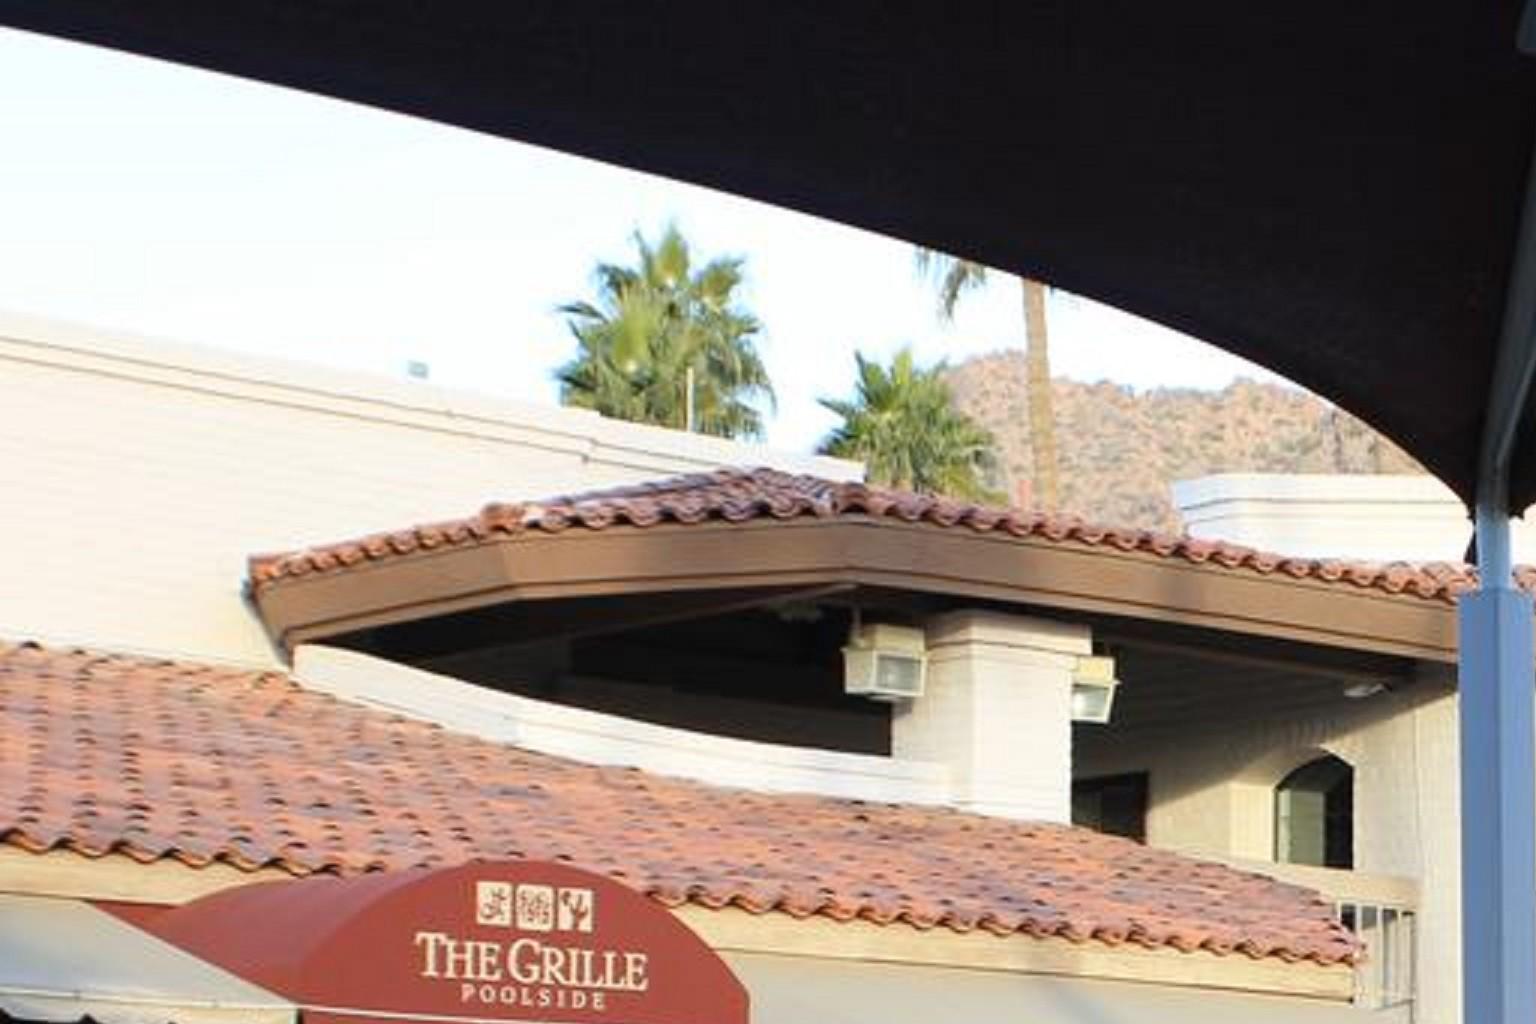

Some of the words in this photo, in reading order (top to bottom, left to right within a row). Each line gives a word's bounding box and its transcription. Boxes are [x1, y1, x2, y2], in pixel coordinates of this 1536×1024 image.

[415, 932, 502, 980] THE
[507, 938, 649, 991] GRILLE
[461, 983, 606, 1010] POOLSIDE
